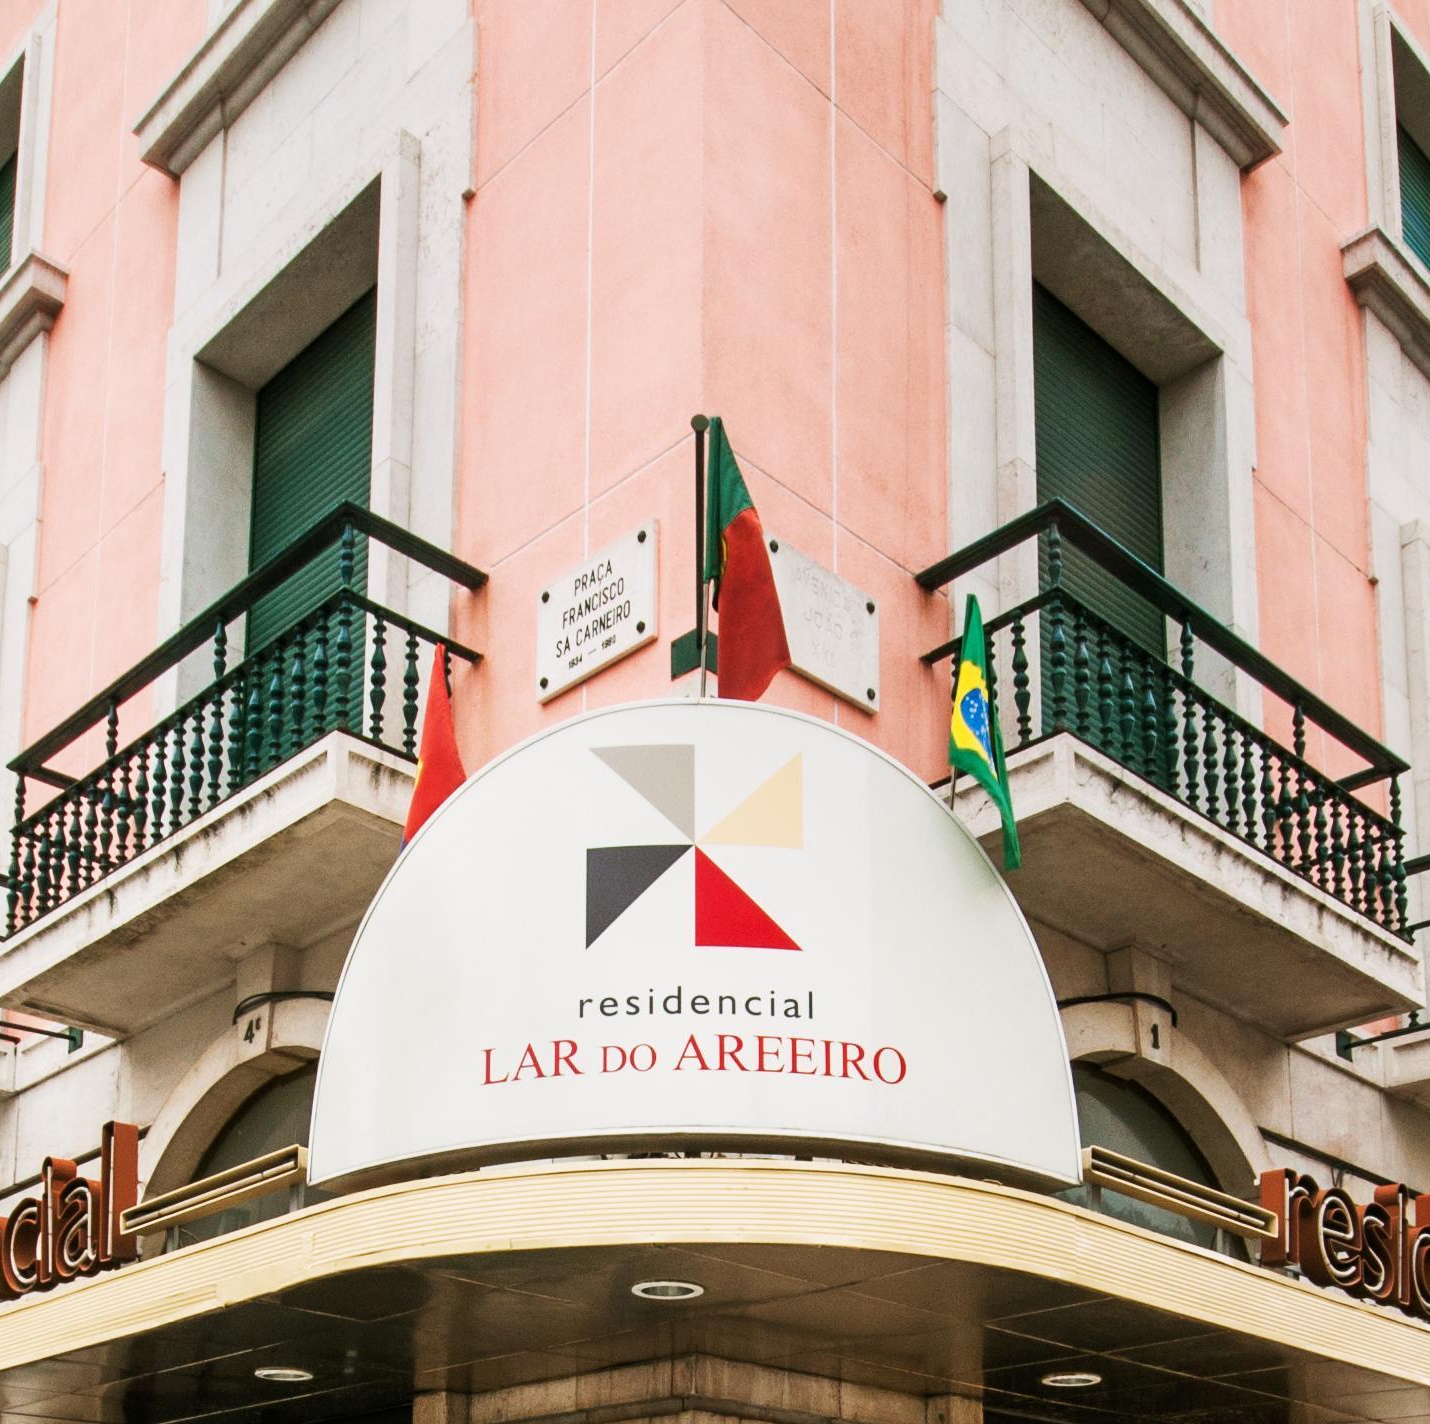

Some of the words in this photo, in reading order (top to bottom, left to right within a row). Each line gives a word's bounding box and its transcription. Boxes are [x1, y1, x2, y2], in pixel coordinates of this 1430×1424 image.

[562, 577, 624, 629] FRANCISCO
[575, 600, 631, 647] CARNEIRO
[579, 985, 814, 1019] residencial
[480, 1039, 585, 1086] LAR
[600, 1043, 657, 1072] DO
[672, 1033, 907, 1085] AREEIRO
